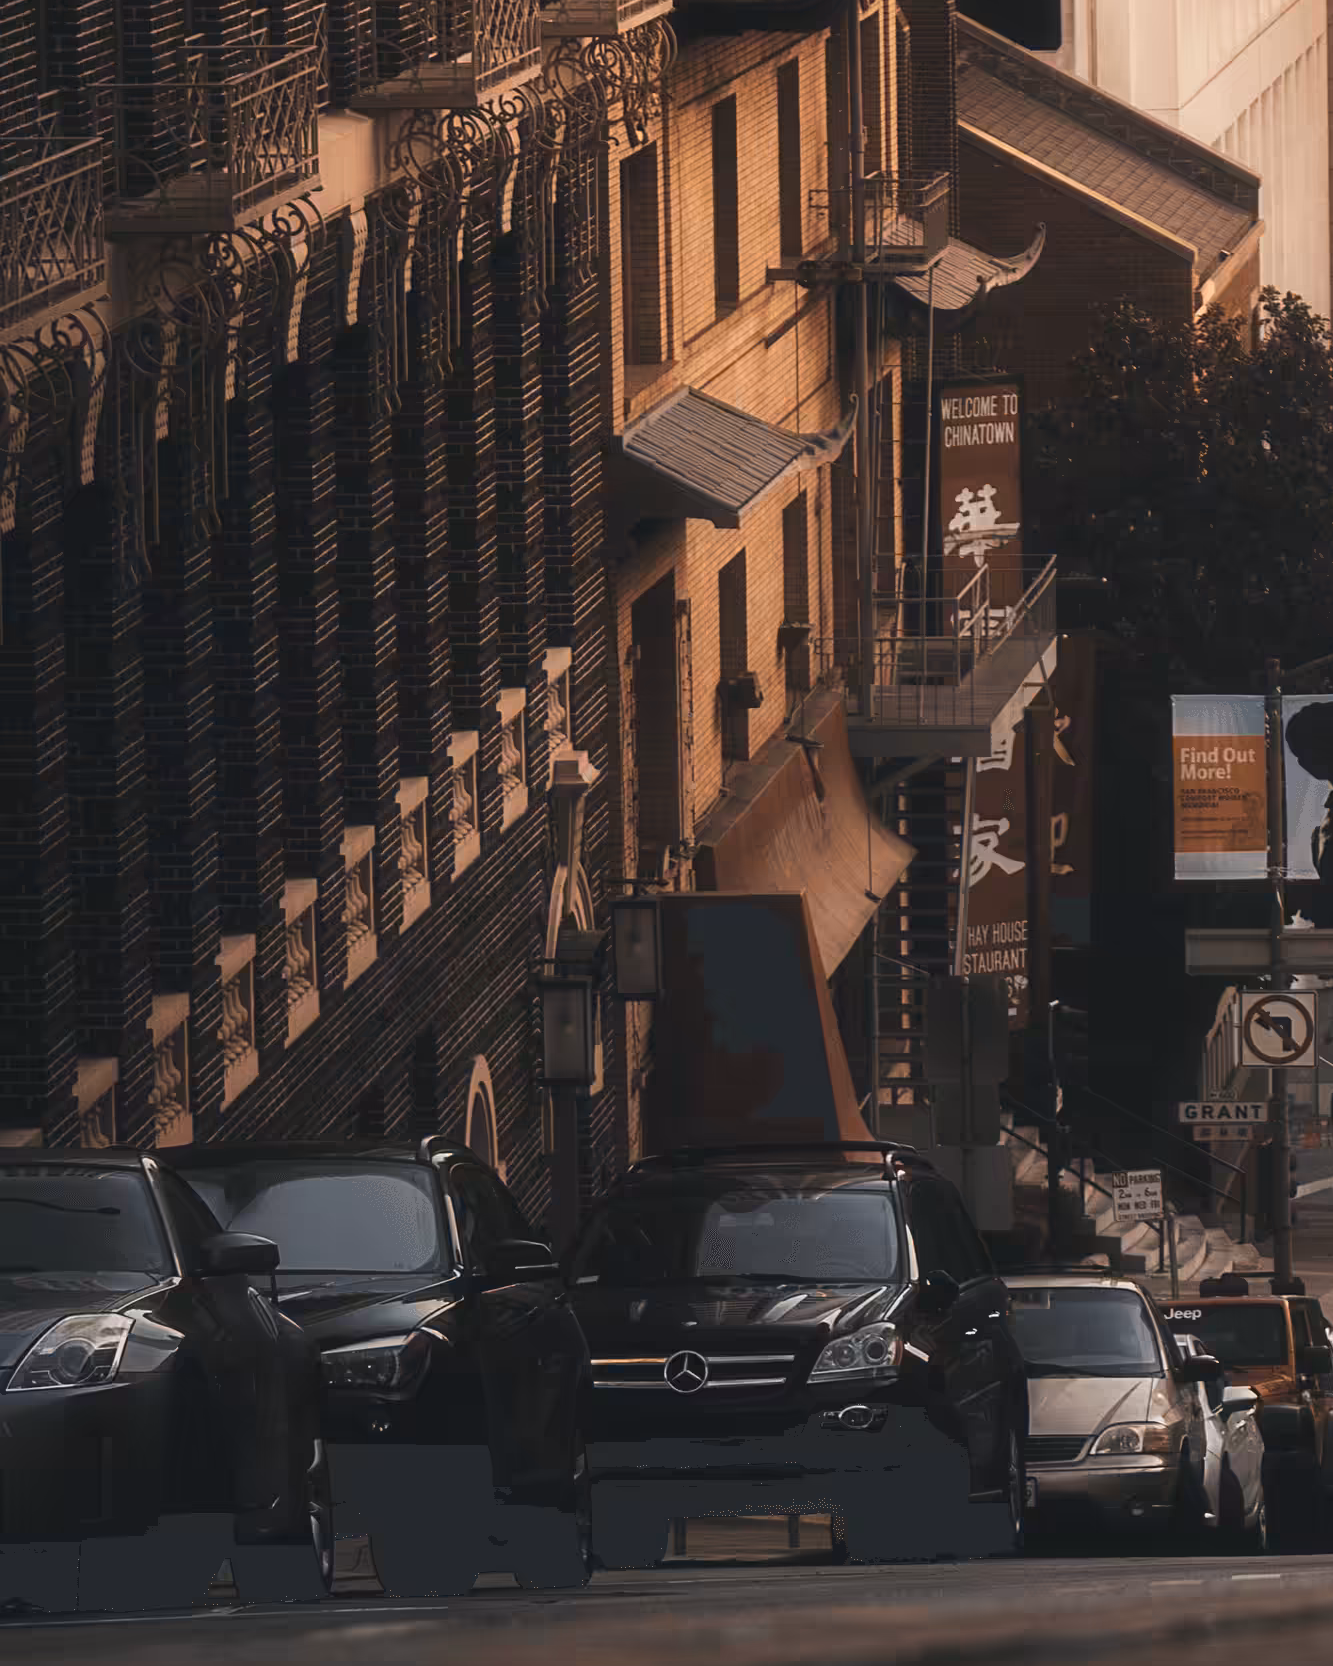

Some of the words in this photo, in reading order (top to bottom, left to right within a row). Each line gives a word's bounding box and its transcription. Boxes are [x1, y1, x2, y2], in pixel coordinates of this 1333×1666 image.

[941, 396, 997, 420] WELCOME
[1002, 393, 1019, 415] TO
[944, 421, 1015, 448] CHINATOWN
[1180, 747, 1219, 764] Find
[1223, 747, 1256, 763] Out
[1180, 764, 1232, 780] More!
[993, 919, 1028, 944] HOUSE
[1185, 1105, 1262, 1119] GRANT
[1113, 1173, 1127, 1186] NO
[1163, 1308, 1202, 1320] Jeep
